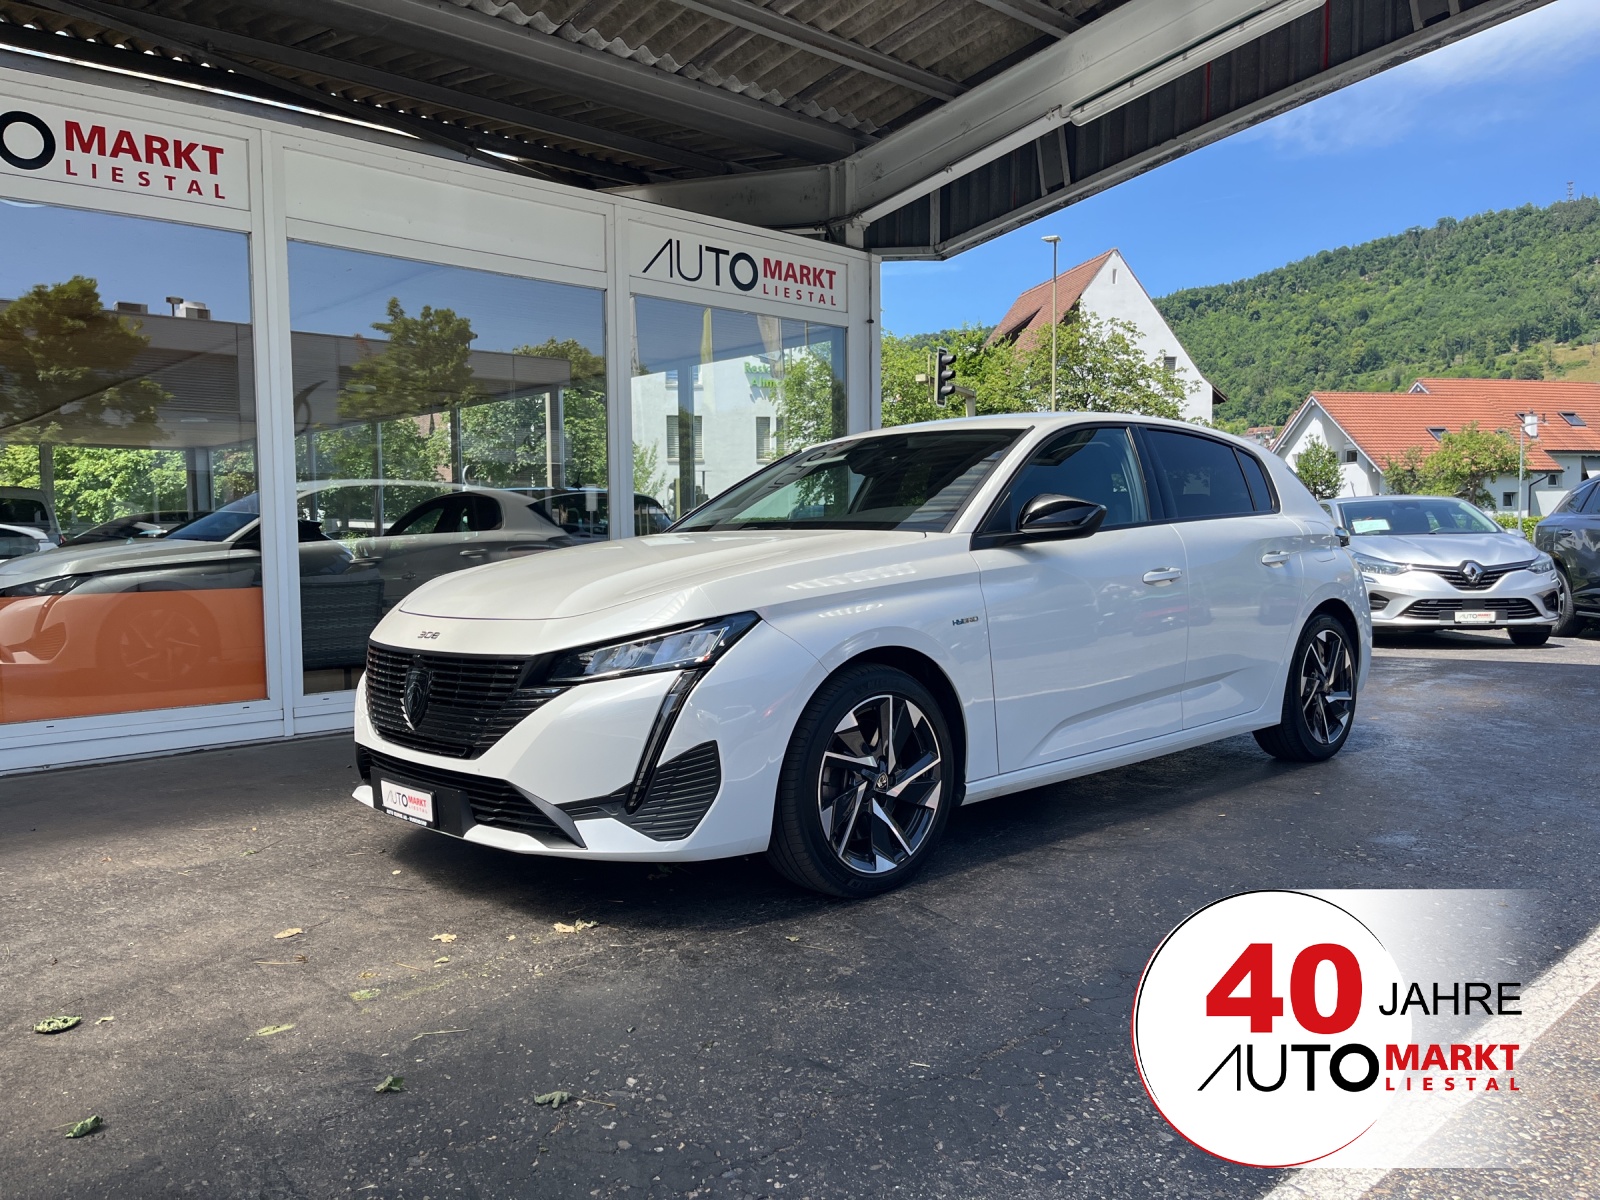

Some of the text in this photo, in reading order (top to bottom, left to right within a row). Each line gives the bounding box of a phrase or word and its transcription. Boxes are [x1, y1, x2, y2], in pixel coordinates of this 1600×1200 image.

[65, 120, 224, 175] MARKT
[65, 159, 225, 199] LIESTAL
[642, 238, 836, 292] AUTO MARKT
[763, 283, 836, 306] LIESTAL
[417, 631, 440, 639] 308
[387, 790, 426, 807] AUTO MARKT
